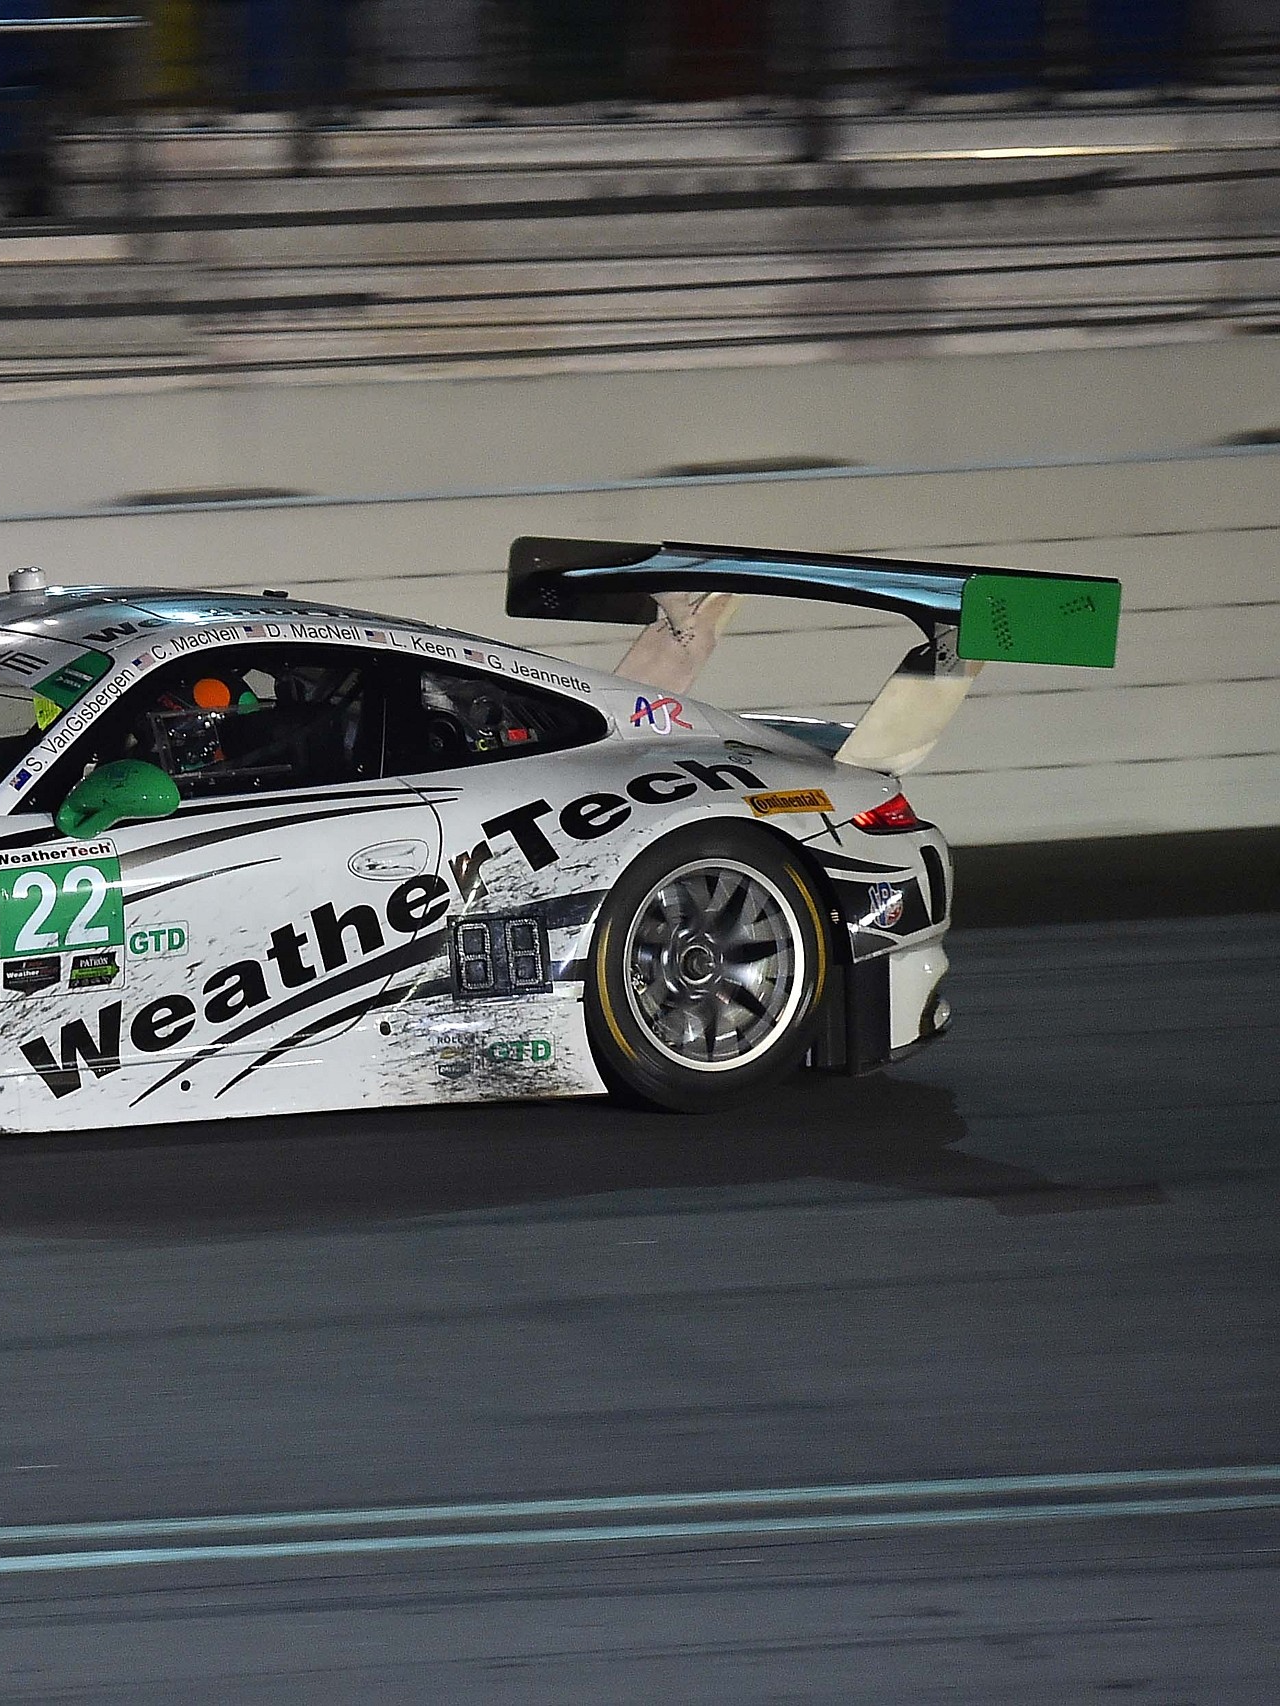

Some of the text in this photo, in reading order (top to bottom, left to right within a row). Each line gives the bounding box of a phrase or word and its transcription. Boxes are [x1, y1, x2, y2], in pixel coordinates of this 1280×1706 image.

[150, 626, 239, 661] C. MacNeil
[266, 624, 288, 640] D.
[292, 624, 360, 642] MacNeil
[390, 634, 457, 660] L. Keen
[488, 654, 592, 695] G. Jeannette
[25, 755, 49, 774] S.
[41, 667, 135, 755] VanGisbergen
[750, 792, 819, 814] Continental
[12, 865, 110, 951] 22
[17, 760, 768, 1098] WeatherTech
[129, 927, 186, 955] GTD
[489, 1039, 552, 1063] GTD
